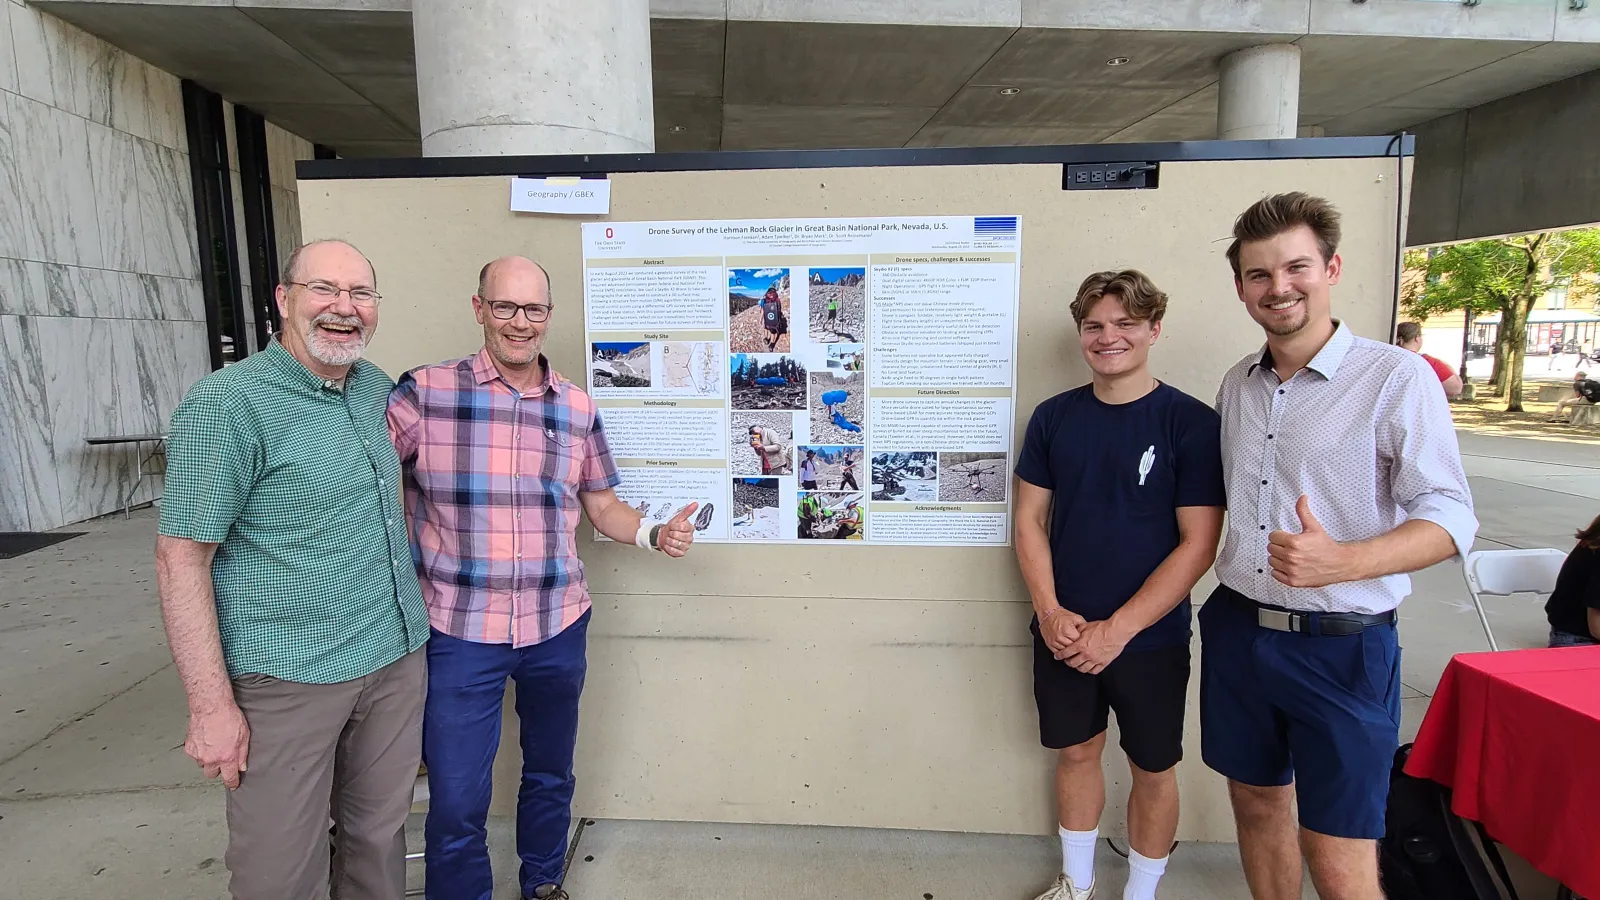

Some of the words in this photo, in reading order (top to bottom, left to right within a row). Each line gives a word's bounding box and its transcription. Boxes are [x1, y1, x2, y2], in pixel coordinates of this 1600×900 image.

[527, 190, 568, 199] Geography
[902, 223, 931, 231] Nevada,
[814, 273, 821, 281] A
[736, 278, 742, 286] G
